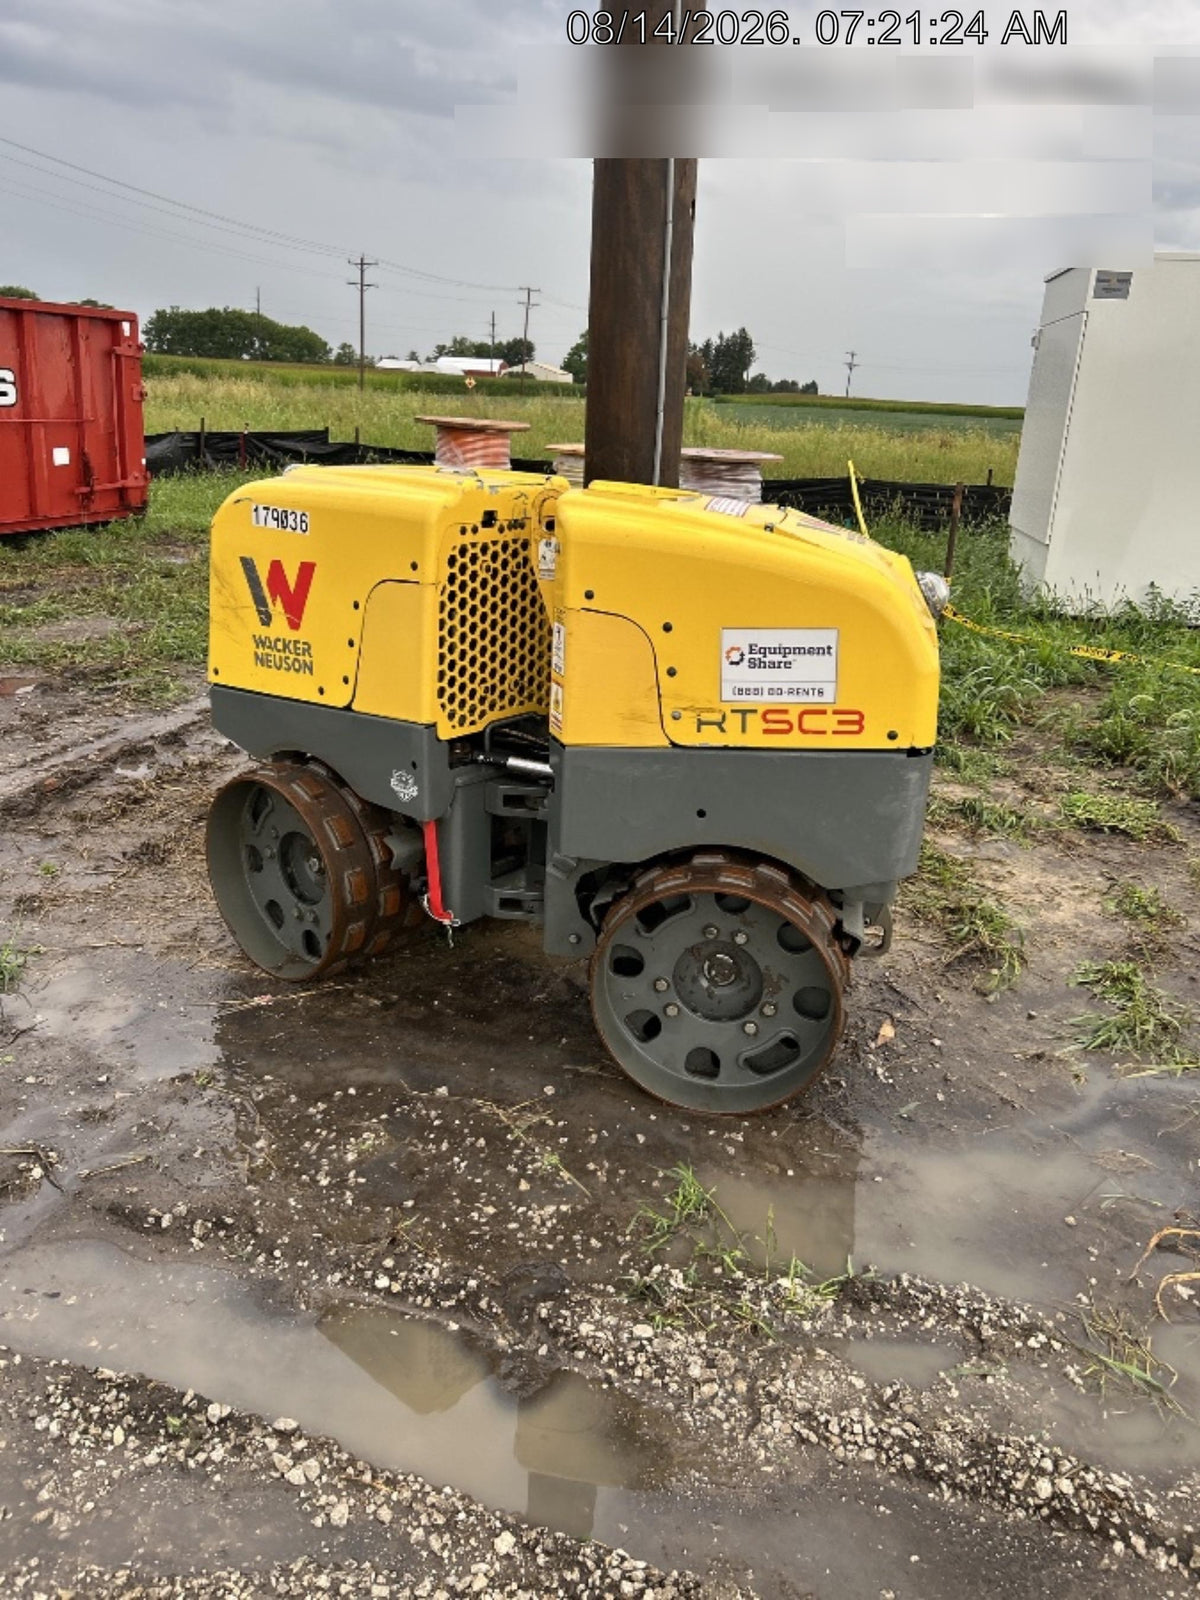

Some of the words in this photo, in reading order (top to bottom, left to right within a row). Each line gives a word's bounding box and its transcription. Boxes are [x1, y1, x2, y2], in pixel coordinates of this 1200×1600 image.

[253, 504, 309, 534] 179036
[252, 633, 313, 659] WACKER
[747, 643, 833, 659] Equipment
[253, 650, 314, 676] NEUSON
[696, 708, 865, 735] RTSC3
